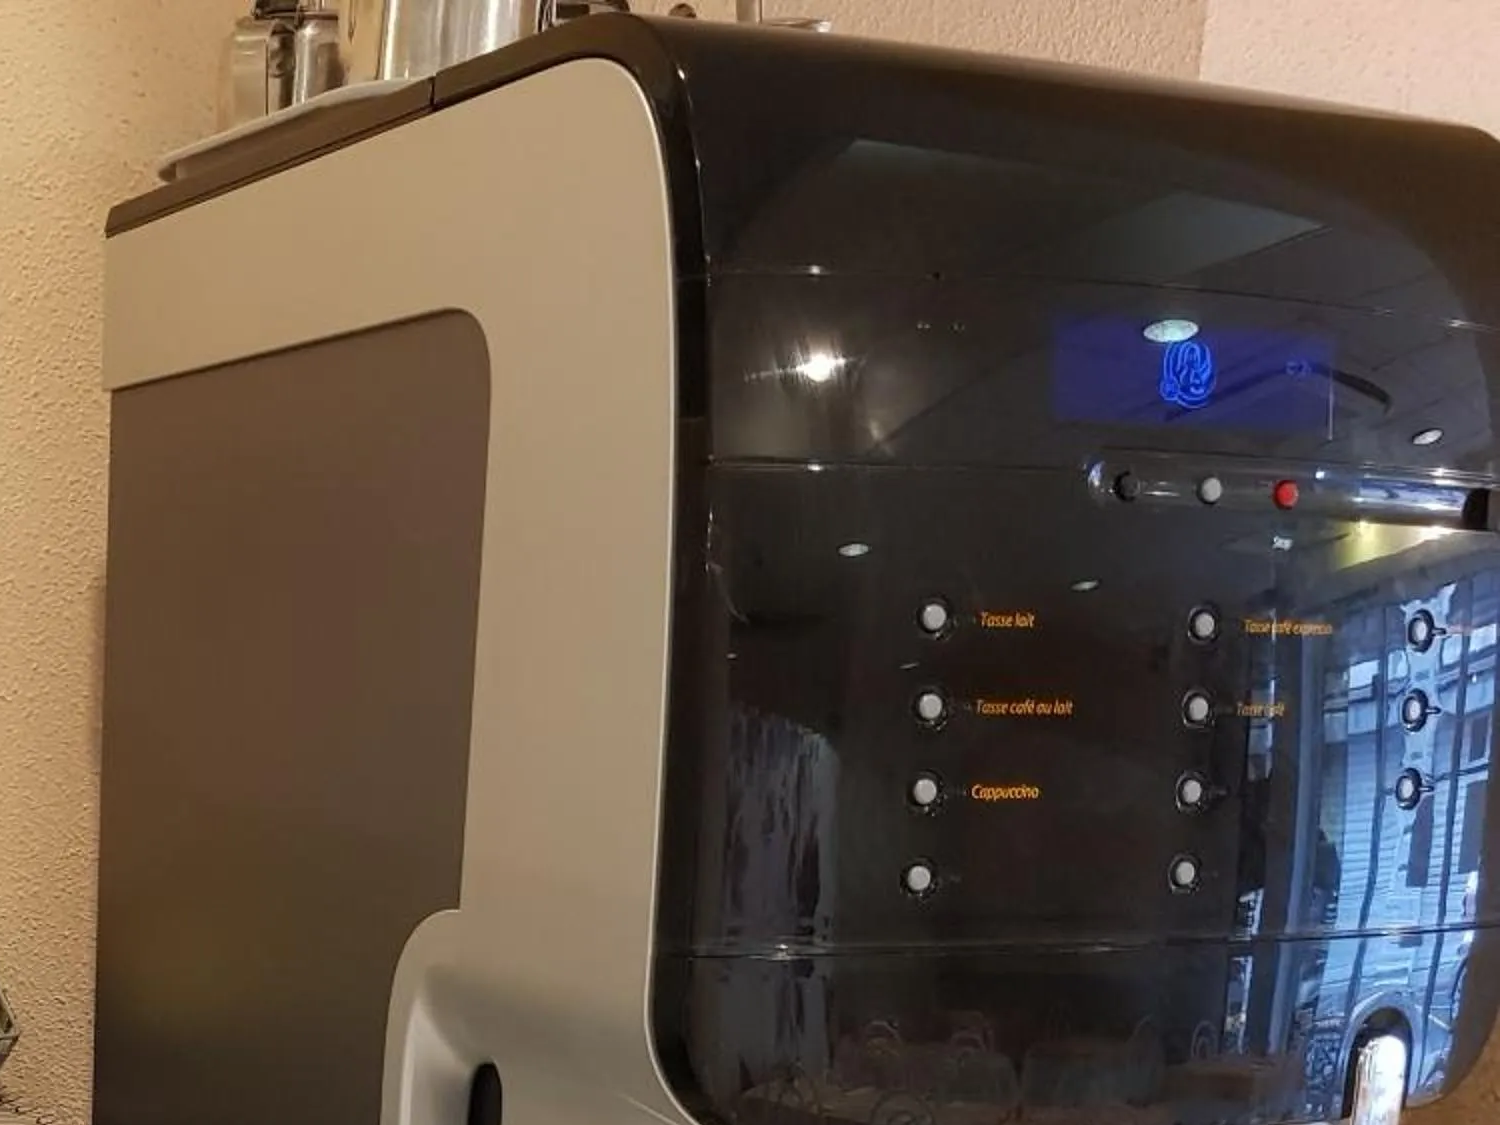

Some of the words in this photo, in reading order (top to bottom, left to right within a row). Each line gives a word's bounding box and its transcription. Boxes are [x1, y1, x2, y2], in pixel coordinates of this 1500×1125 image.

[980, 612, 1013, 627] Tasse
[976, 699, 1008, 714] Tasse
[1009, 698, 1035, 714] café
[972, 784, 1040, 800] Cappuccino
